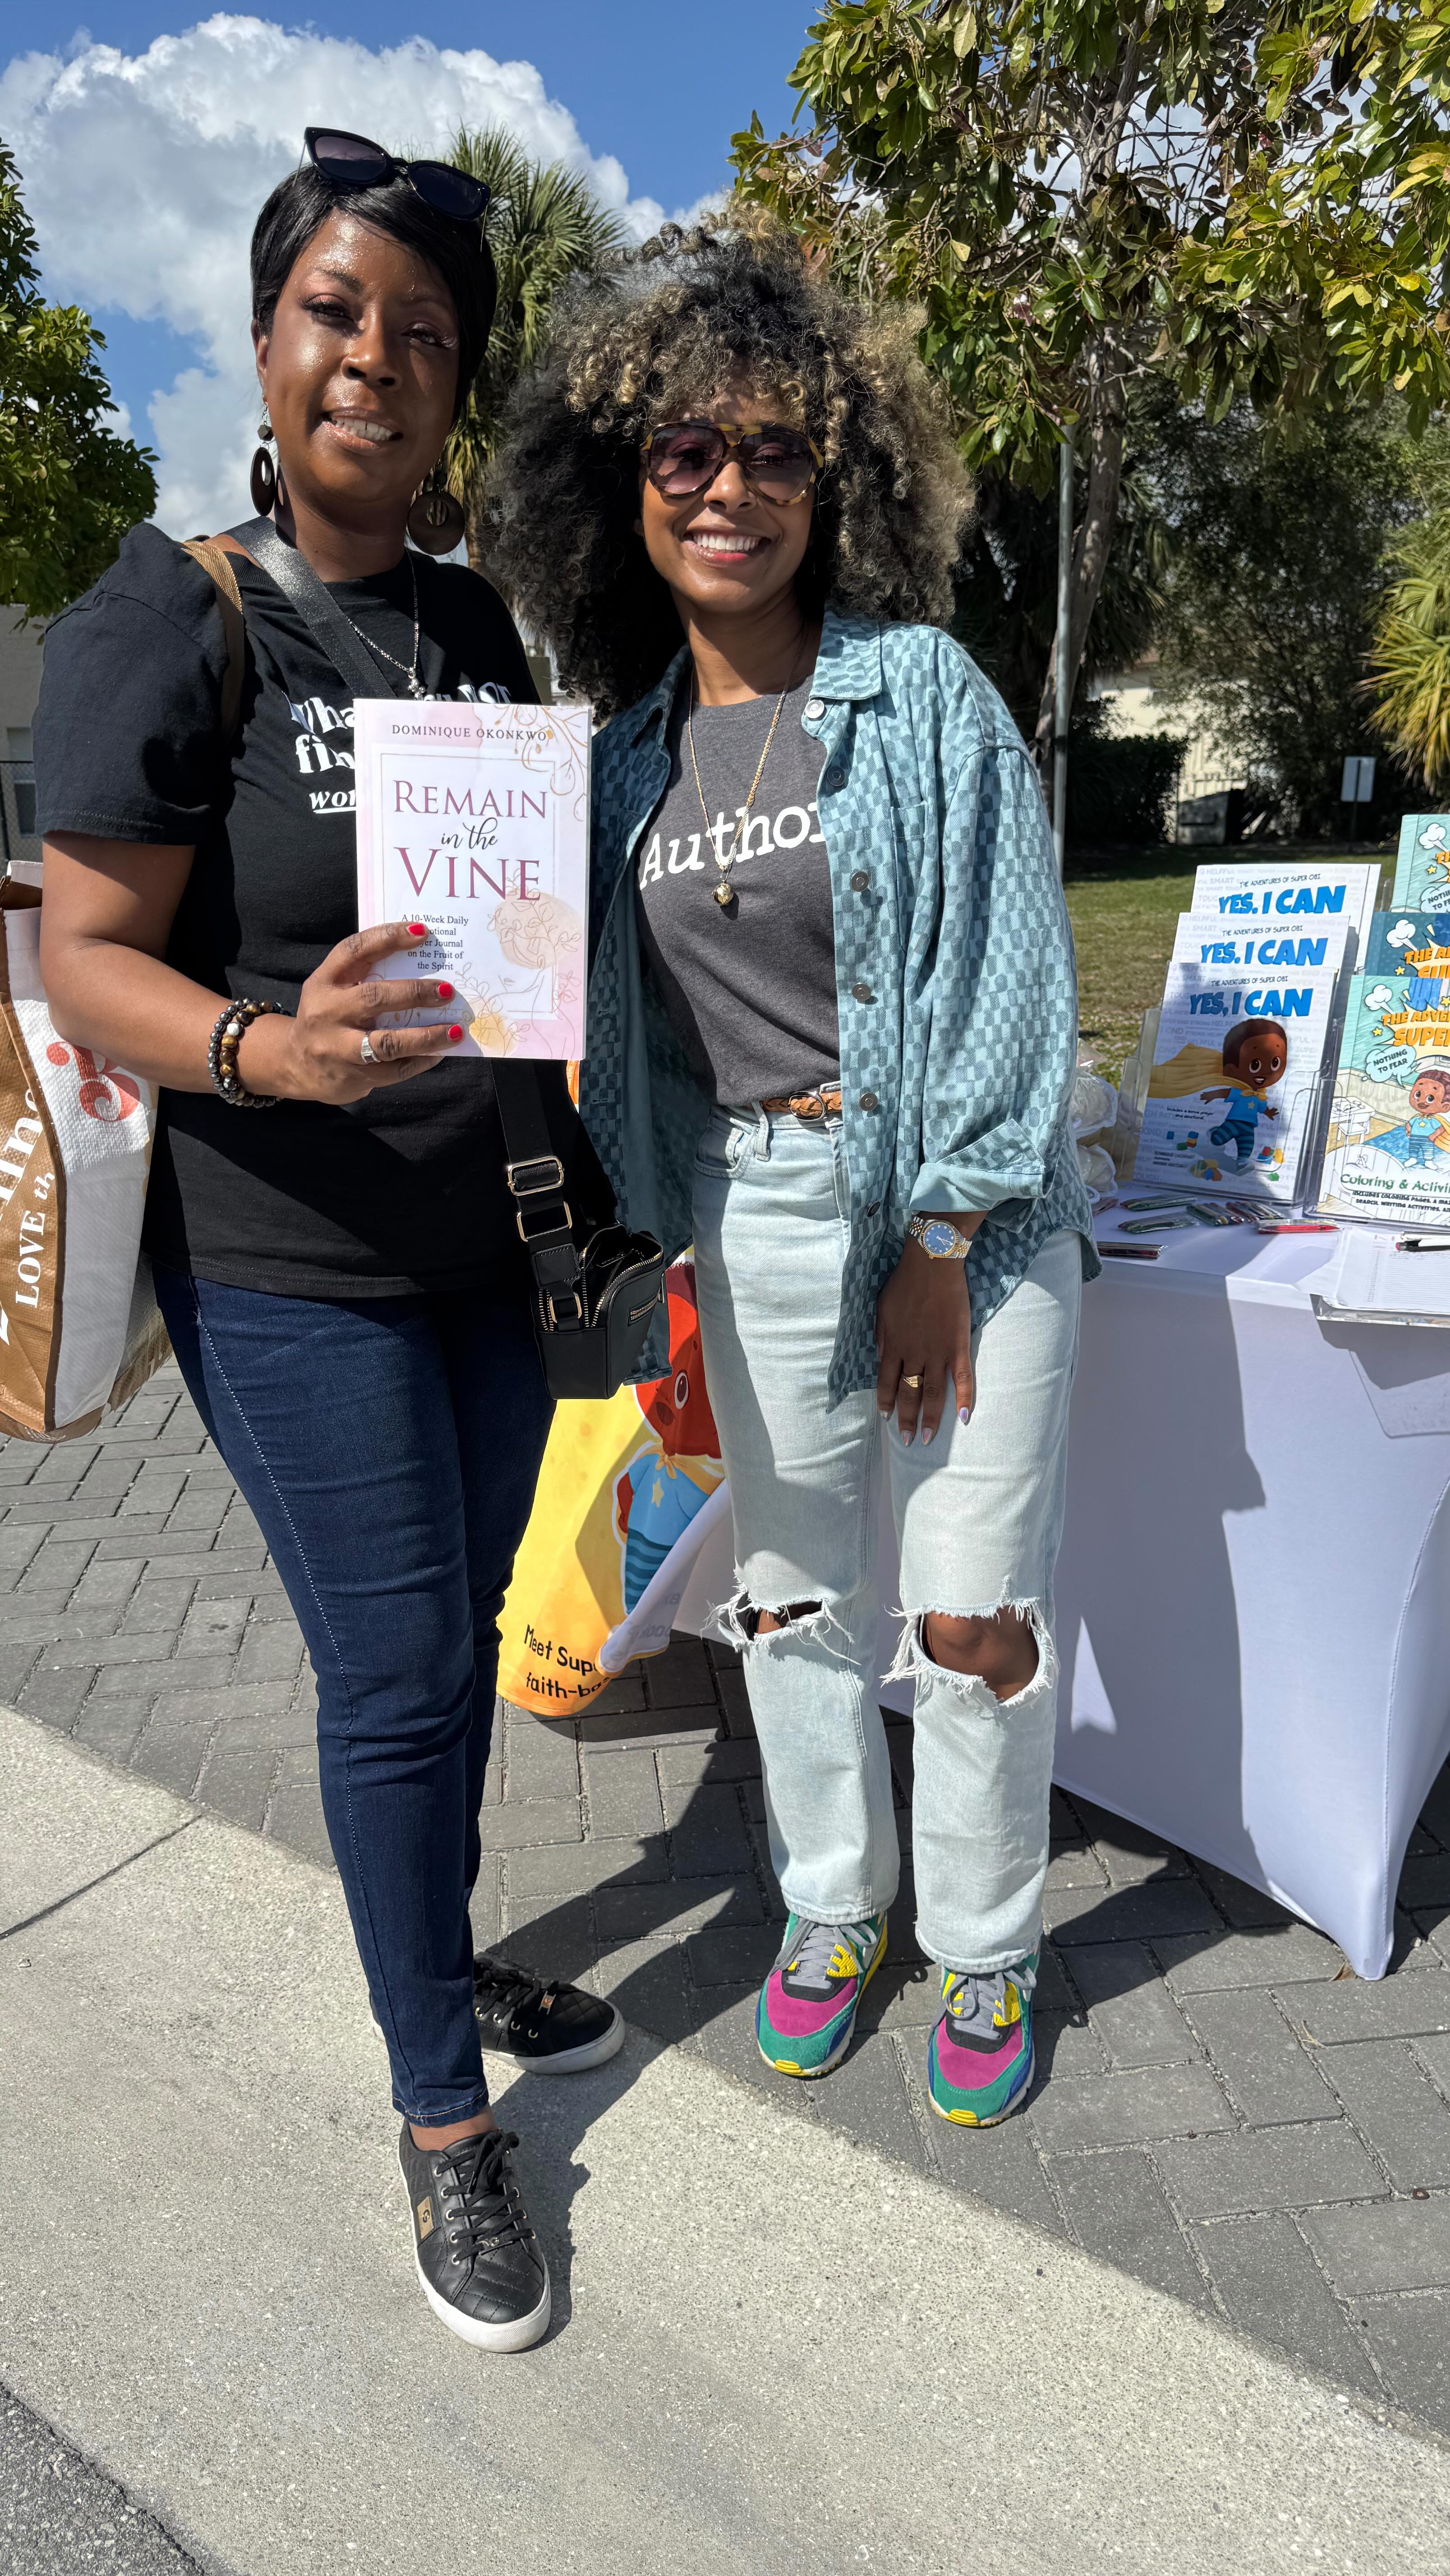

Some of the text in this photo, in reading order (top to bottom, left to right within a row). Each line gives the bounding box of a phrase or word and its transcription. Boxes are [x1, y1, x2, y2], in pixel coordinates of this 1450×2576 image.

[392, 725, 547, 741] DOMINIQUE OKONKWO
[393, 780, 548, 819] REMAIN
[441, 817, 498, 850] in the
[394, 846, 541, 901] VINE
[1250, 877, 1281, 887] ADVENTURES
[1262, 891, 1273, 914] I
[1275, 885, 1347, 914] CAN
[401, 914, 469, 926] A 10-Week Daily
[1233, 928, 1264, 936] ADVENTURES
[434, 939, 463, 948] Journal
[434, 950, 453, 959] Fruit
[454, 951, 464, 960] of
[1244, 941, 1255, 964] I
[1257, 938, 1328, 966] CAN
[1404, 948, 1433, 964] THE
[418, 961, 454, 972] the Spirit
[1221, 978, 1250, 986] ADVENTURES
[1190, 988, 1313, 1017] YES, I CAN
[1381, 1011, 1409, 1026] THE
[1373, 1049, 1408, 1066] NOTHING
[1389, 1058, 1408, 1070] FEAR
[1340, 1173, 1394, 1190] Coloring
[1399, 1179, 1408, 1189] &
[15, 1209, 46, 1309] LOVE
[524, 1624, 553, 1661] Meet
